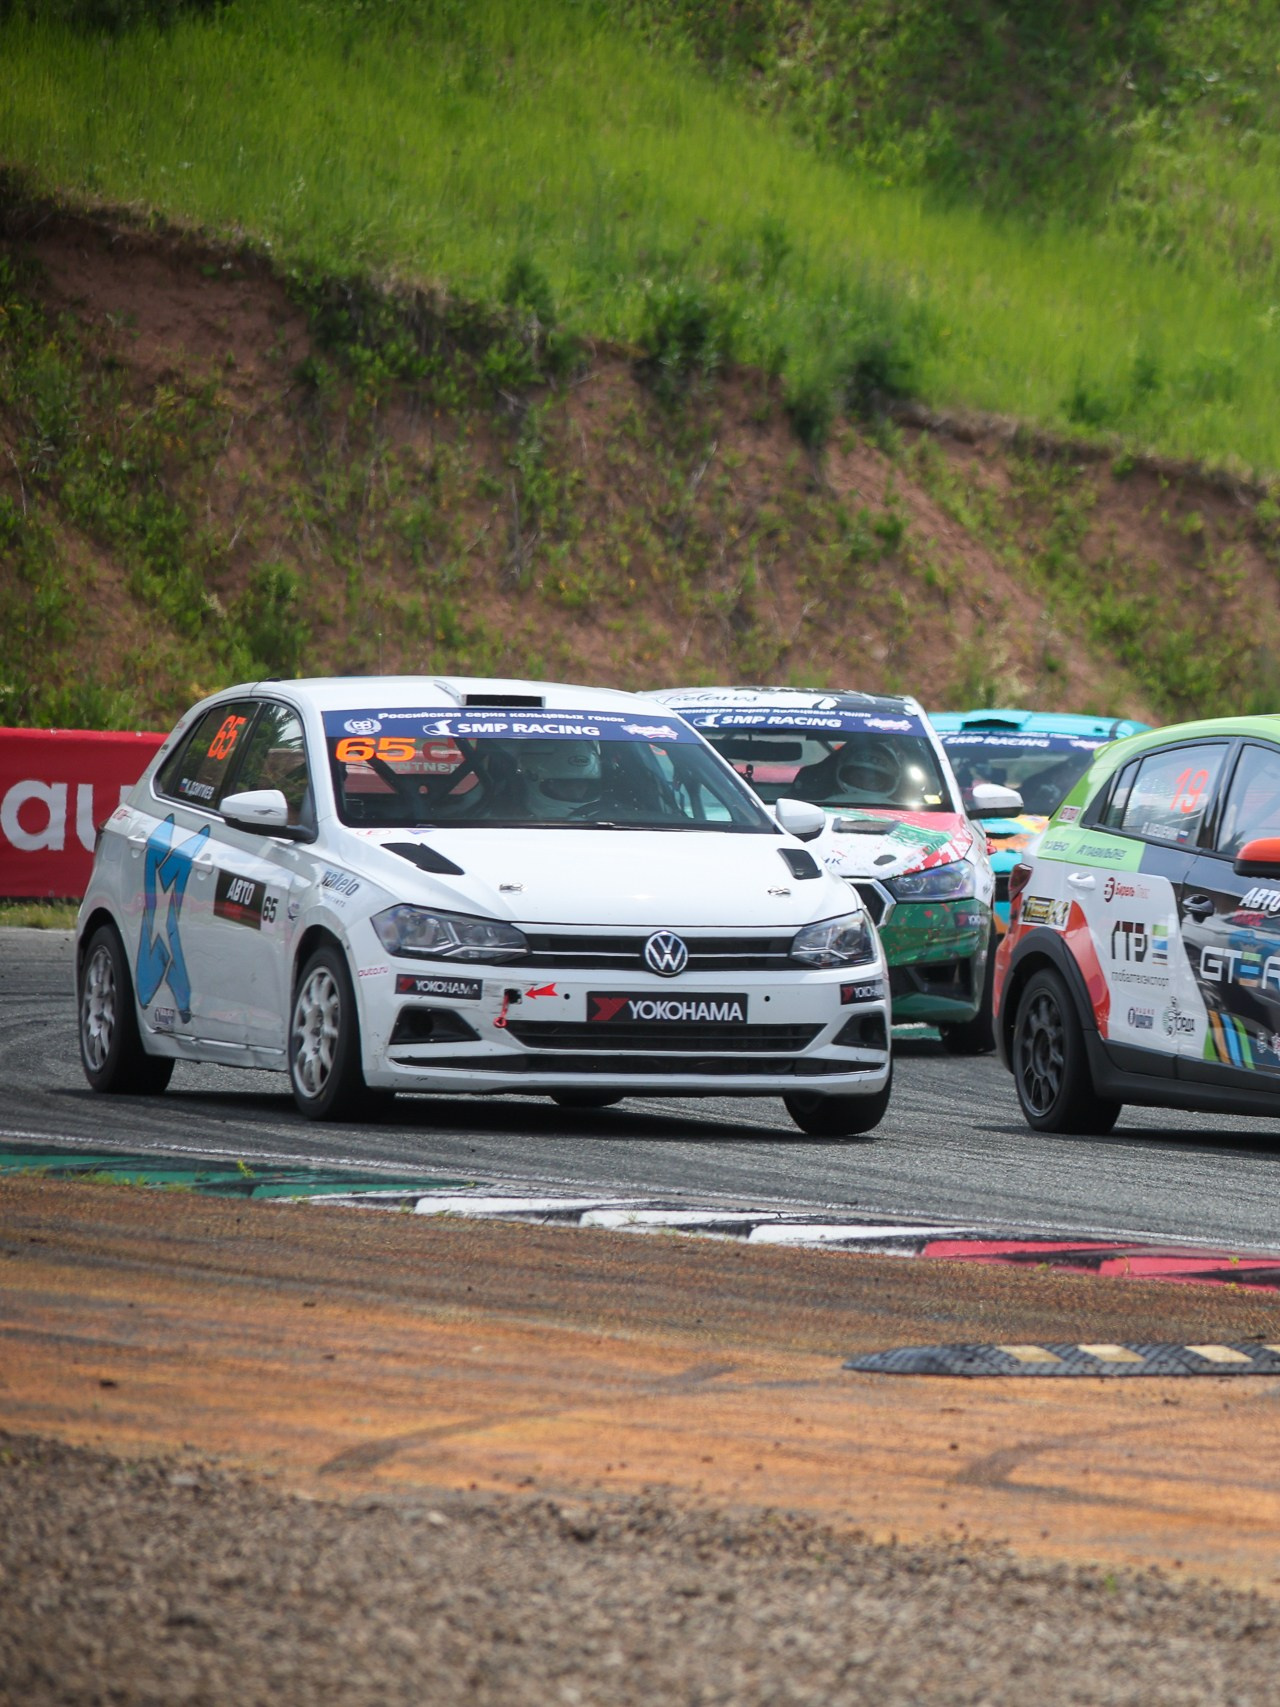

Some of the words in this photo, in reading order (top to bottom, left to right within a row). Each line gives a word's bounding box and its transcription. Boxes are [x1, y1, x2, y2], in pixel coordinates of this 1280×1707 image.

[378, 711, 461, 719] Российская
[510, 712, 584, 721] кольцевых
[588, 714, 626, 722] гонок
[721, 716, 765, 725] SMP
[767, 716, 843, 728] RACING
[207, 714, 248, 760] 65
[458, 723, 508, 733] SMP
[512, 723, 600, 736] RACING
[335, 736, 416, 762] 65
[984, 737, 1050, 747] RACING
[1169, 767, 1209, 814] 19
[226, 877, 256, 905] АВТО
[262, 895, 279, 924] 65
[416, 980, 479, 995] YOKOHAMA
[628, 1000, 743, 1021] YOKOHAMA
